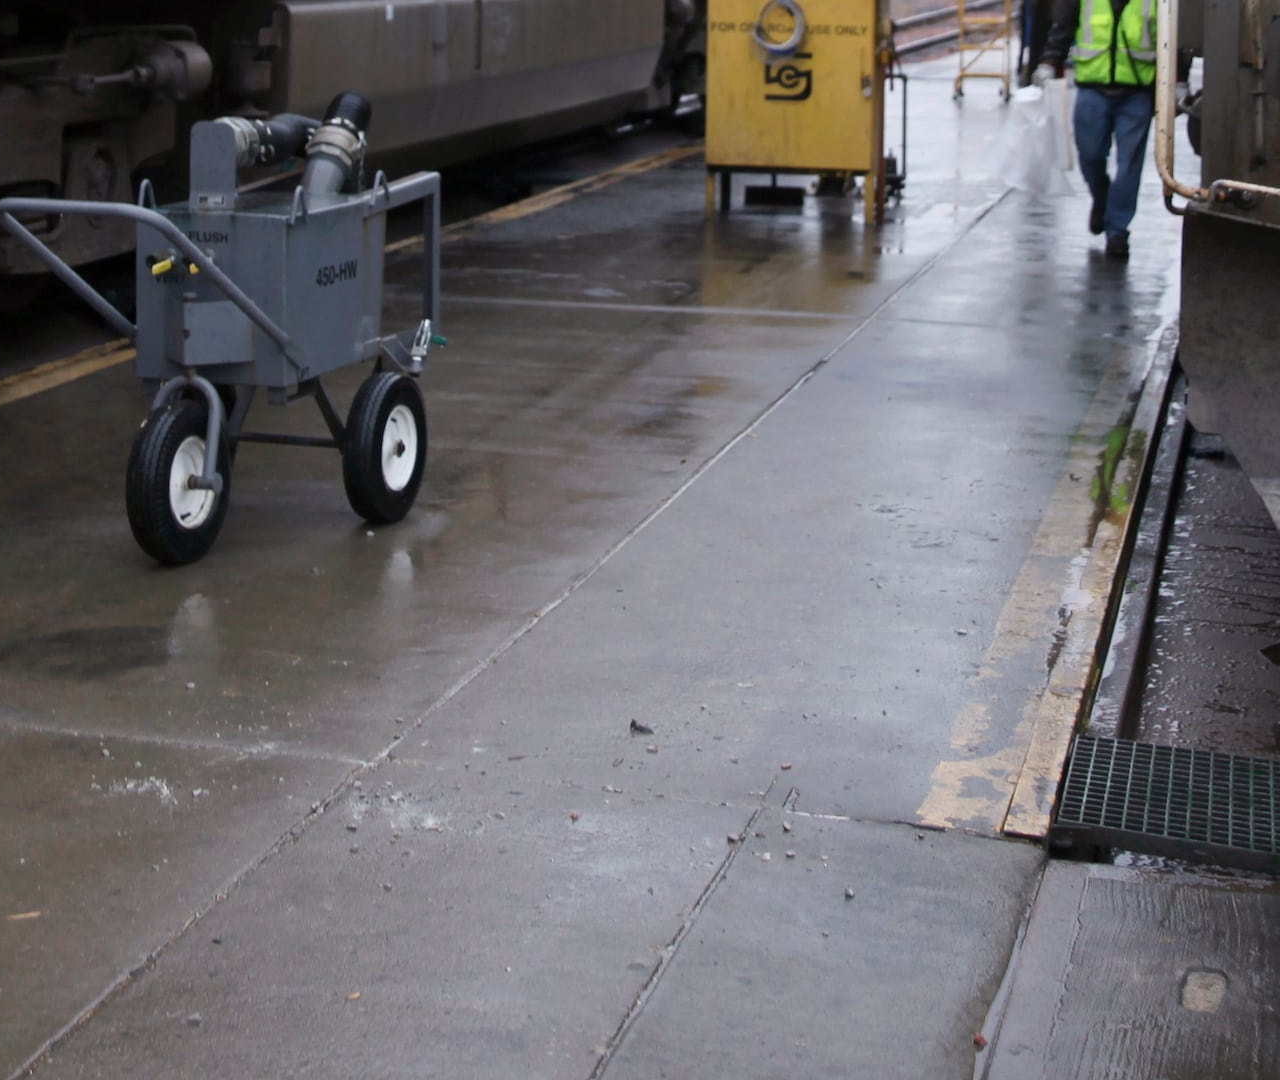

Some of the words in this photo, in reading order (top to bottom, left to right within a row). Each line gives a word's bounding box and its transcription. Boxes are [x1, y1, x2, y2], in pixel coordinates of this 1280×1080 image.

[710, 22, 736, 34] FOR
[807, 23, 830, 35] USE
[834, 24, 869, 37] ONLY
[316, 258, 358, 287] 450-HW
